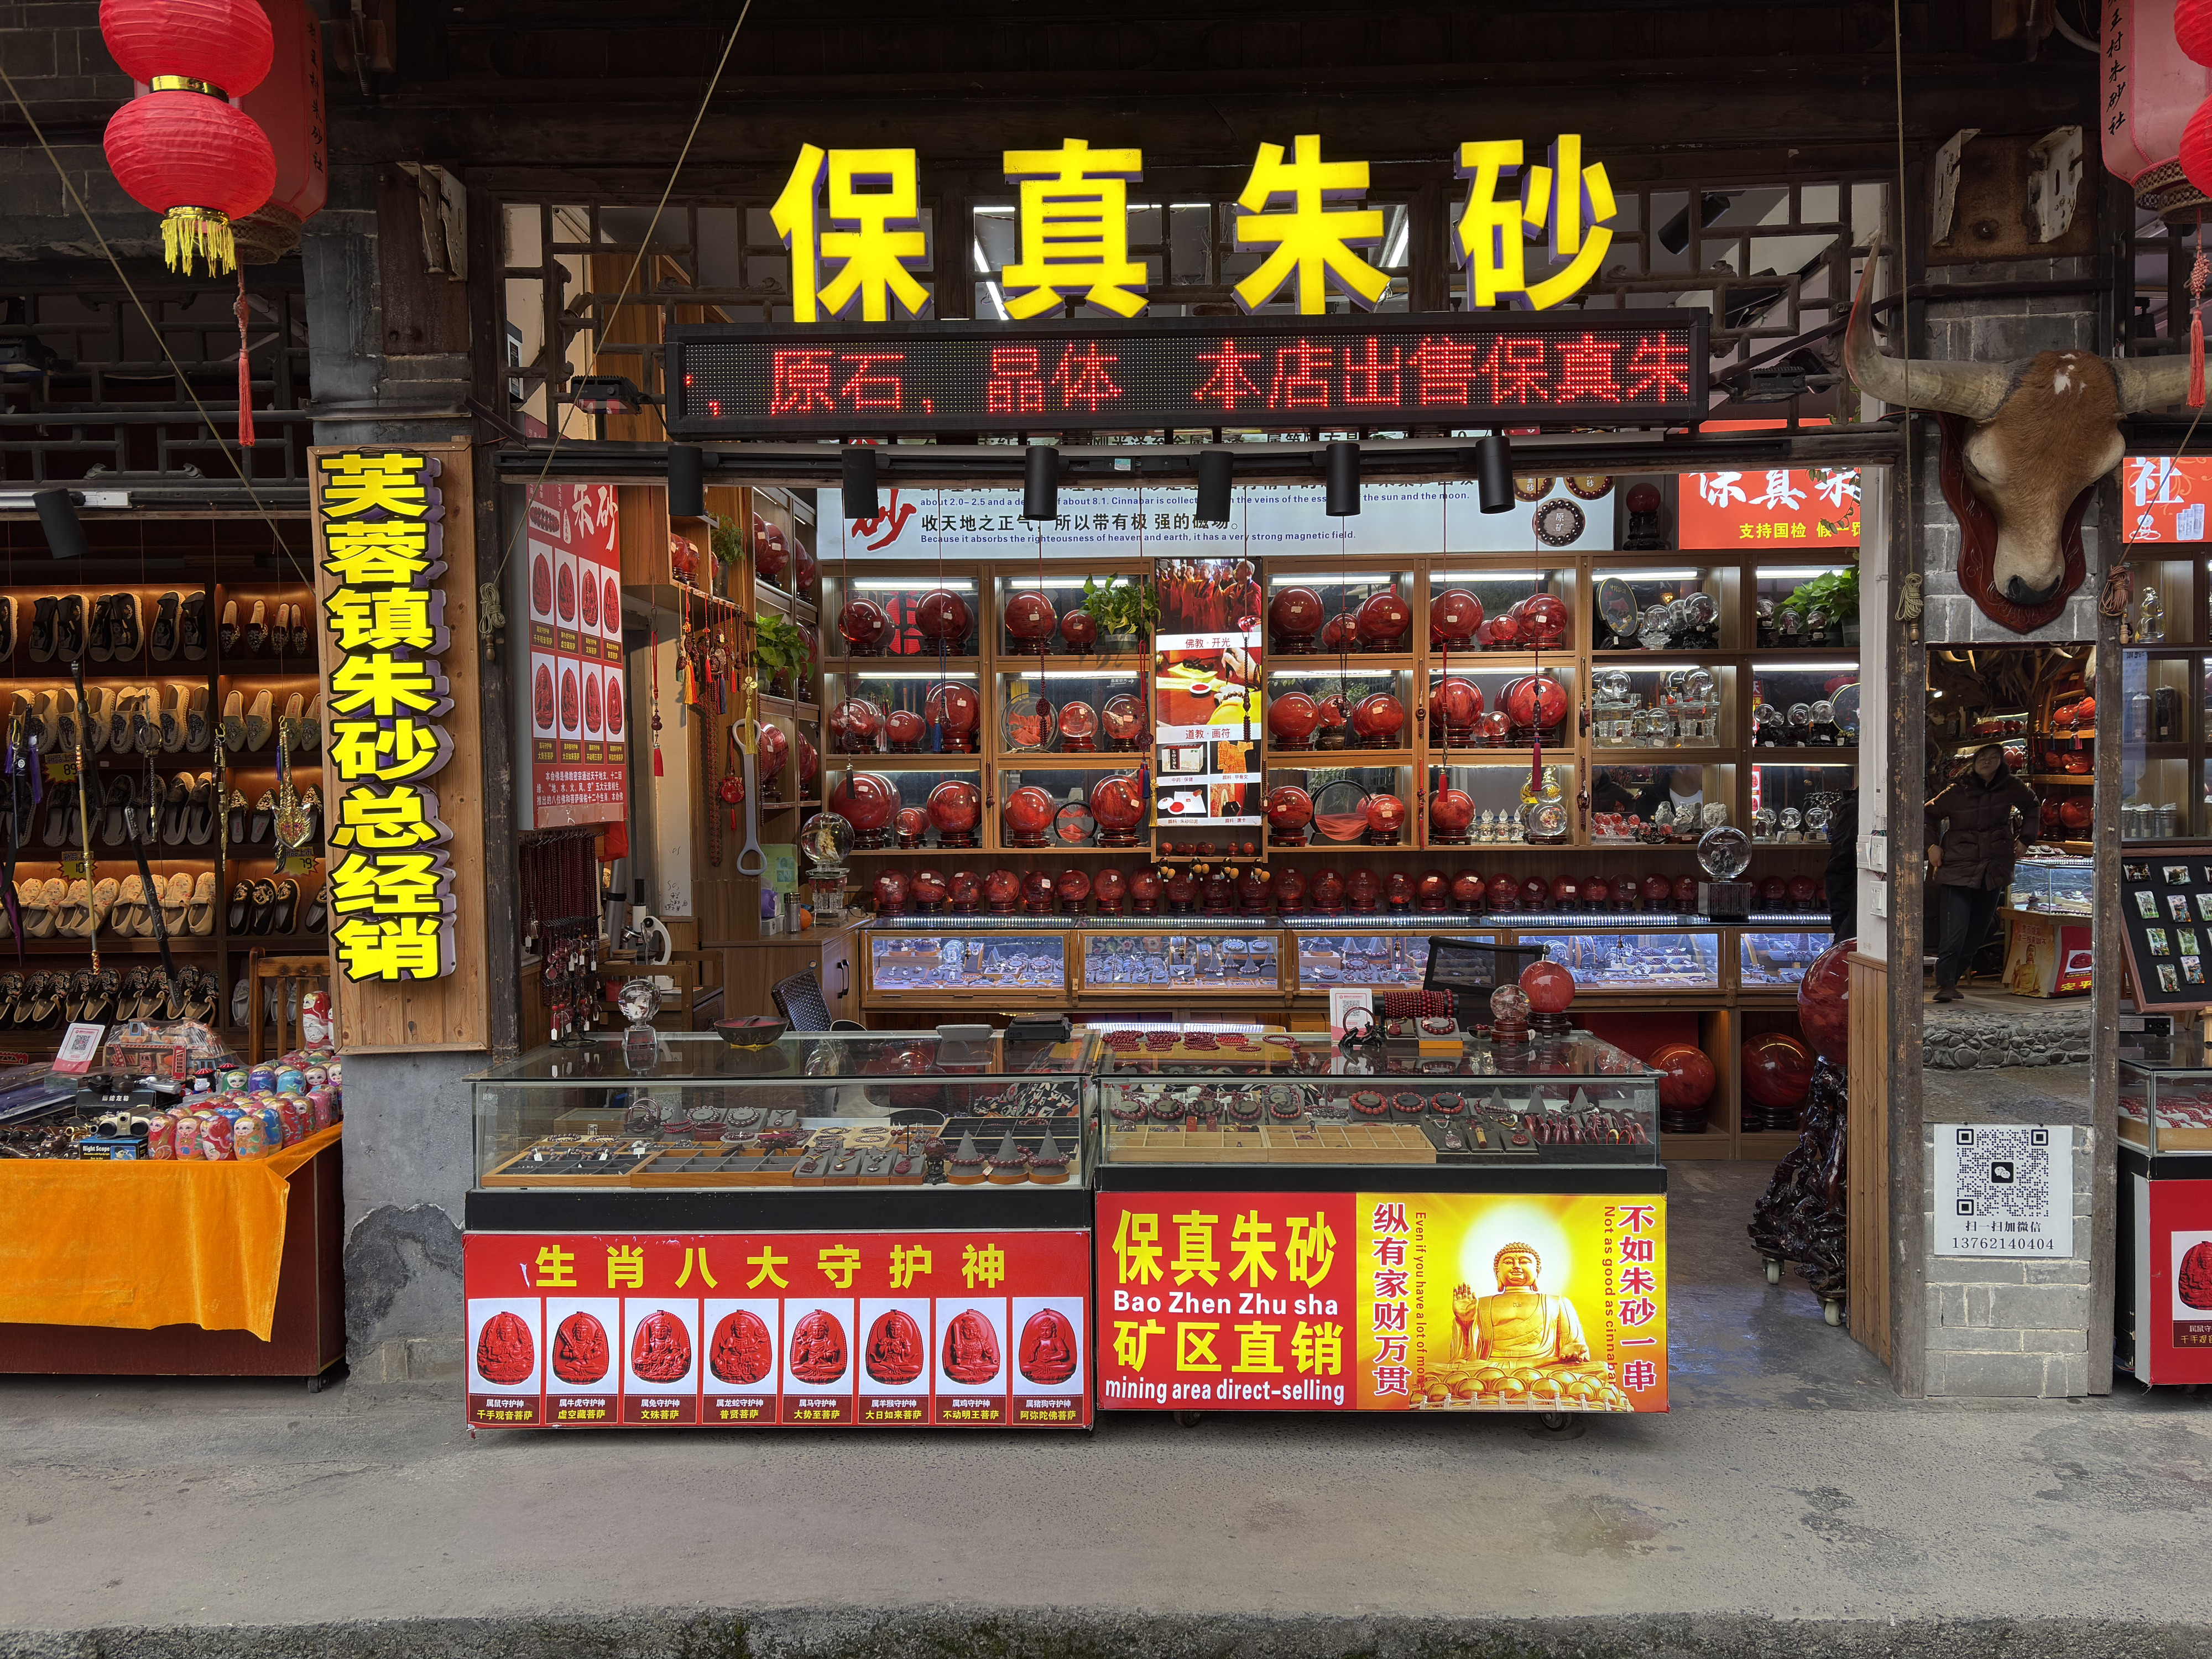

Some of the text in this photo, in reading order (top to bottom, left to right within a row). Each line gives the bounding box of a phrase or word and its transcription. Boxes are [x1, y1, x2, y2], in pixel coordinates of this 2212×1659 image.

[770, 134, 1617, 323] 保真朱砂
[1193, 333, 1689, 409] 本店出售保真朱
[988, 498, 1005, 506] and
[1237, 495, 1252, 504] the
[1282, 495, 1291, 503] of
[1555, 512, 1564, 532] 原矿
[1739, 523, 1807, 539] 支持国检
[921, 535, 959, 543] Because
[1027, 534, 1094, 545] righteousness
[1164, 534, 1192, 542] earth,
[1229, 534, 1250, 542] very
[1251, 533, 1283, 542] strong
[1285, 532, 1330, 541] magnetic
[325, 452, 444, 982] 芙蓉镇朱砂总经销
[63, 763, 77, 775] 89
[63, 852, 92, 861] 新品上
[76, 862, 87, 874] 10
[299, 858, 312, 869] 79
[1415, 1212, 1427, 1241] Even
[1965, 1220, 2042, 1233] 扫一扫加微信
[1112, 1209, 1337, 1289] 保真朱砂
[1416, 1245, 1427, 1253] if
[1952, 1237, 2055, 1250] 13762140404
[535, 1243, 1005, 1290] 生肖八大守护神
[1413, 1256, 1424, 1278] you
[1372, 1202, 1412, 1397] 纵有家财万贯
[1415, 1281, 1427, 1310] have
[1602, 1206, 1618, 1387] Not as good as cinnabar
[1618, 1203, 1657, 1392] 不如朱砂一串
[1114, 1290, 1338, 1316] Bao Zhen Zhu sha
[1416, 1322, 1427, 1339] lot
[2189, 1324, 2212, 1333] 属鼠守
[1112, 1318, 1344, 1376] 矿区直销
[1416, 1342, 1428, 1353] of
[1105, 1376, 1167, 1405] mining
[1172, 1383, 1212, 1400] area
[485, 1399, 525, 1408] 属鼠守护神
[559, 1399, 606, 1408] 属牛虎守护神
[640, 1399, 681, 1407] 属兔守护神
[716, 1399, 764, 1407] 属龙蛇守护神
[798, 1399, 837, 1408] 属马守护神
[870, 1399, 917, 1408] 属羊猴守护神
[951, 1399, 991, 1408] 属鸡守护神
[1025, 1399, 1072, 1408] 属猪狗守护神
[476, 1409, 533, 1421] 千手观音菩萨
[557, 1409, 606, 1420] 虚空藏菩萨
[640, 1410, 680, 1420] 文殊菩萨
[720, 1409, 759, 1420] 普贤菩萨
[794, 1410, 841, 1420] 大势至菩萨
[865, 1410, 922, 1420] 大日如来菩萨
[942, 1410, 1000, 1420] 不动明王菩萨
[1020, 1410, 1077, 1421] 阿弥陀佛菩萨
